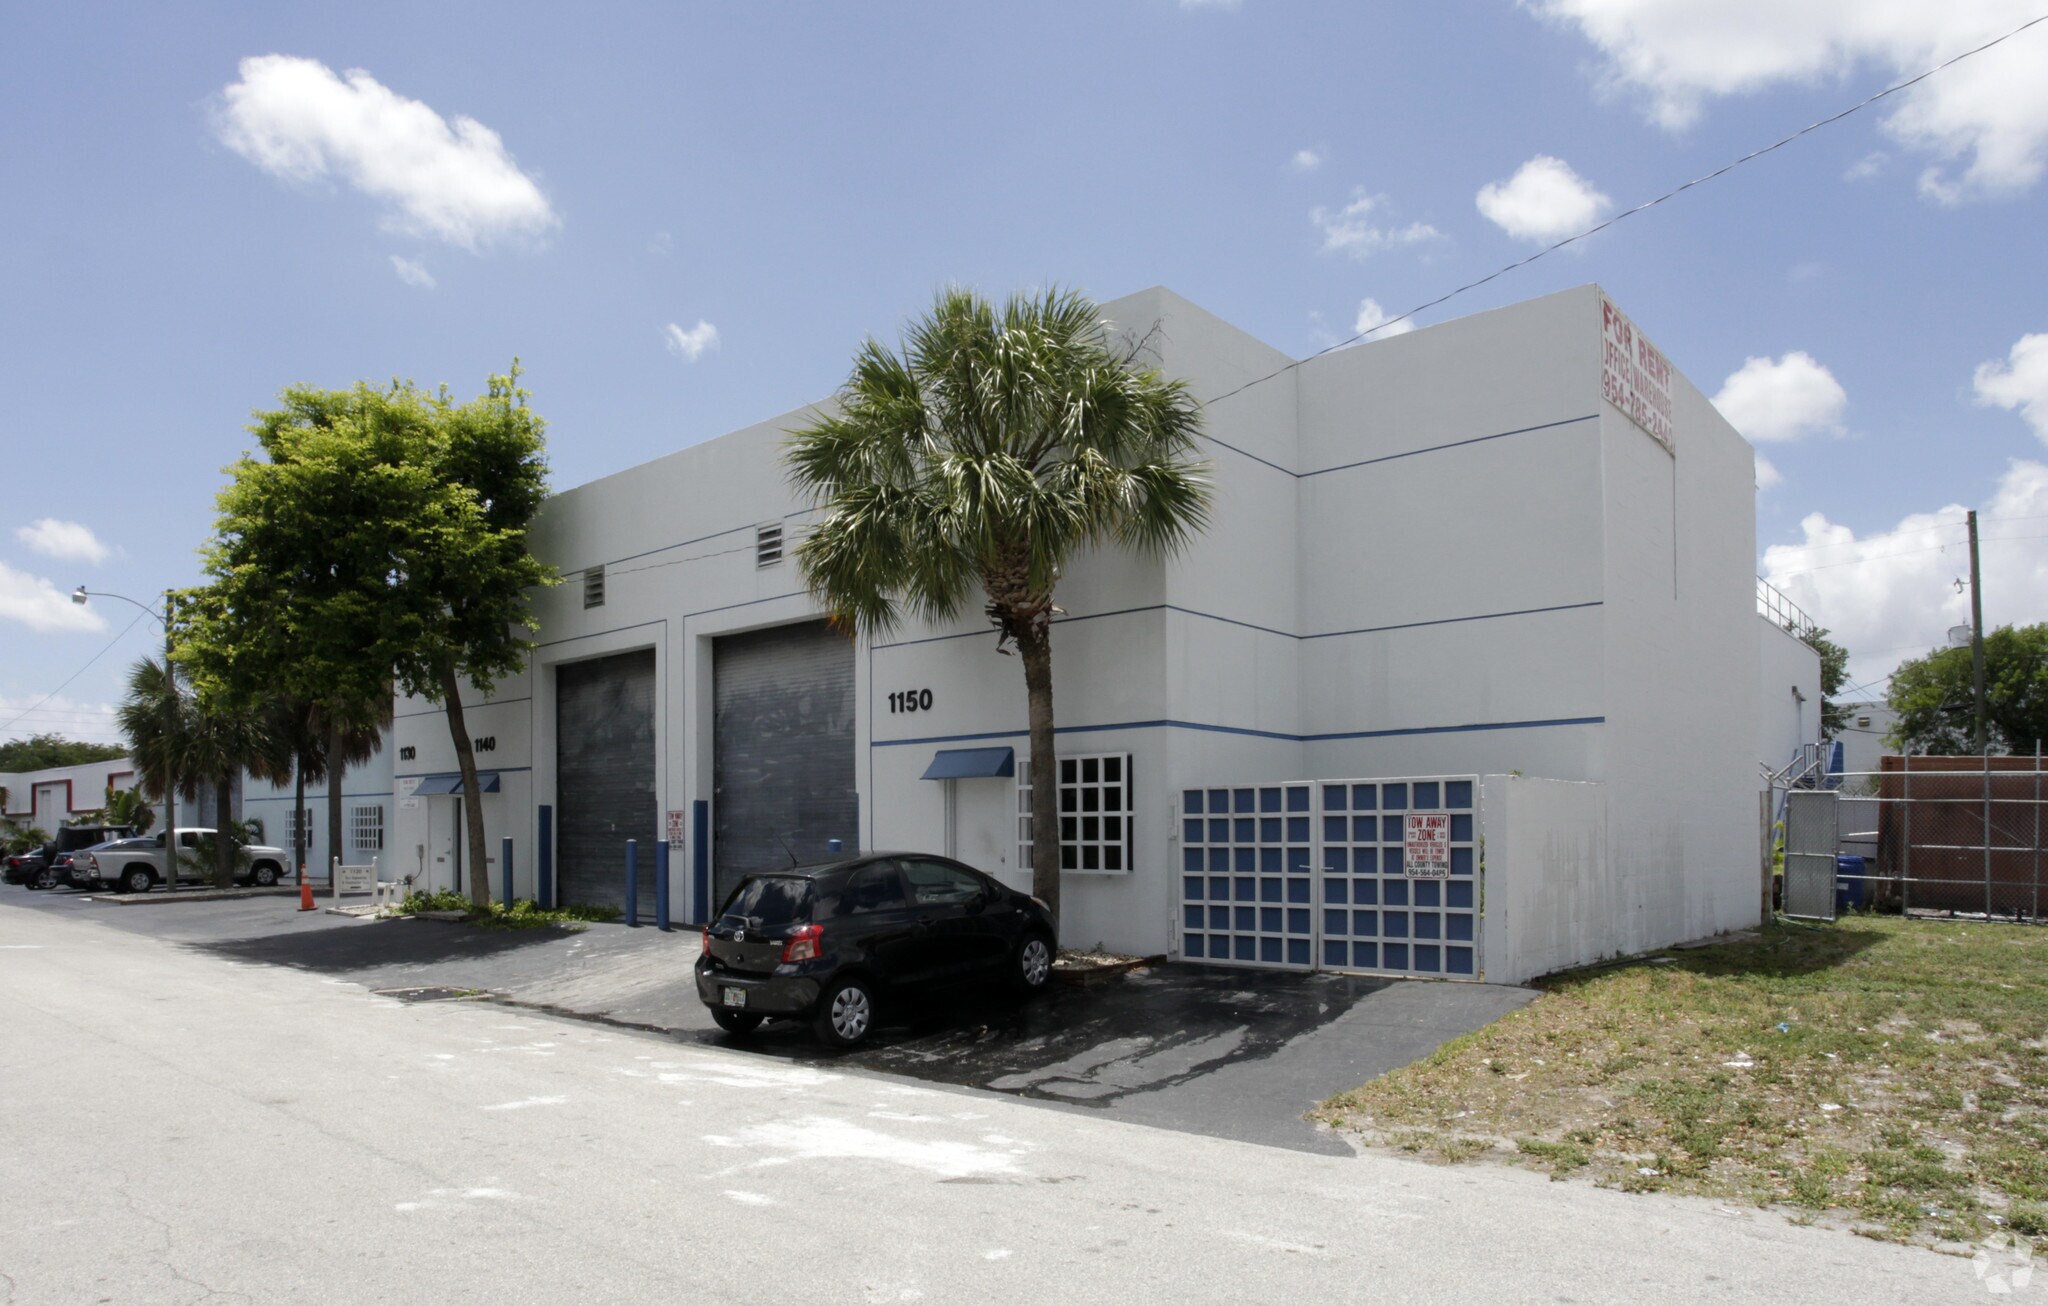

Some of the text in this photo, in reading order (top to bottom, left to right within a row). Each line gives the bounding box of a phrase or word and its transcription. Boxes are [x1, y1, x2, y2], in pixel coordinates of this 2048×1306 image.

[1603, 302, 1671, 393] FOR RENT
[1632, 364, 1672, 424] WAREHOUSE
[888, 688, 933, 714] 1150
[474, 736, 496, 753] 1140
[399, 746, 416, 761] 1130
[1408, 817, 1446, 828] TOW AWAY
[1417, 829, 1436, 841] ZONE
